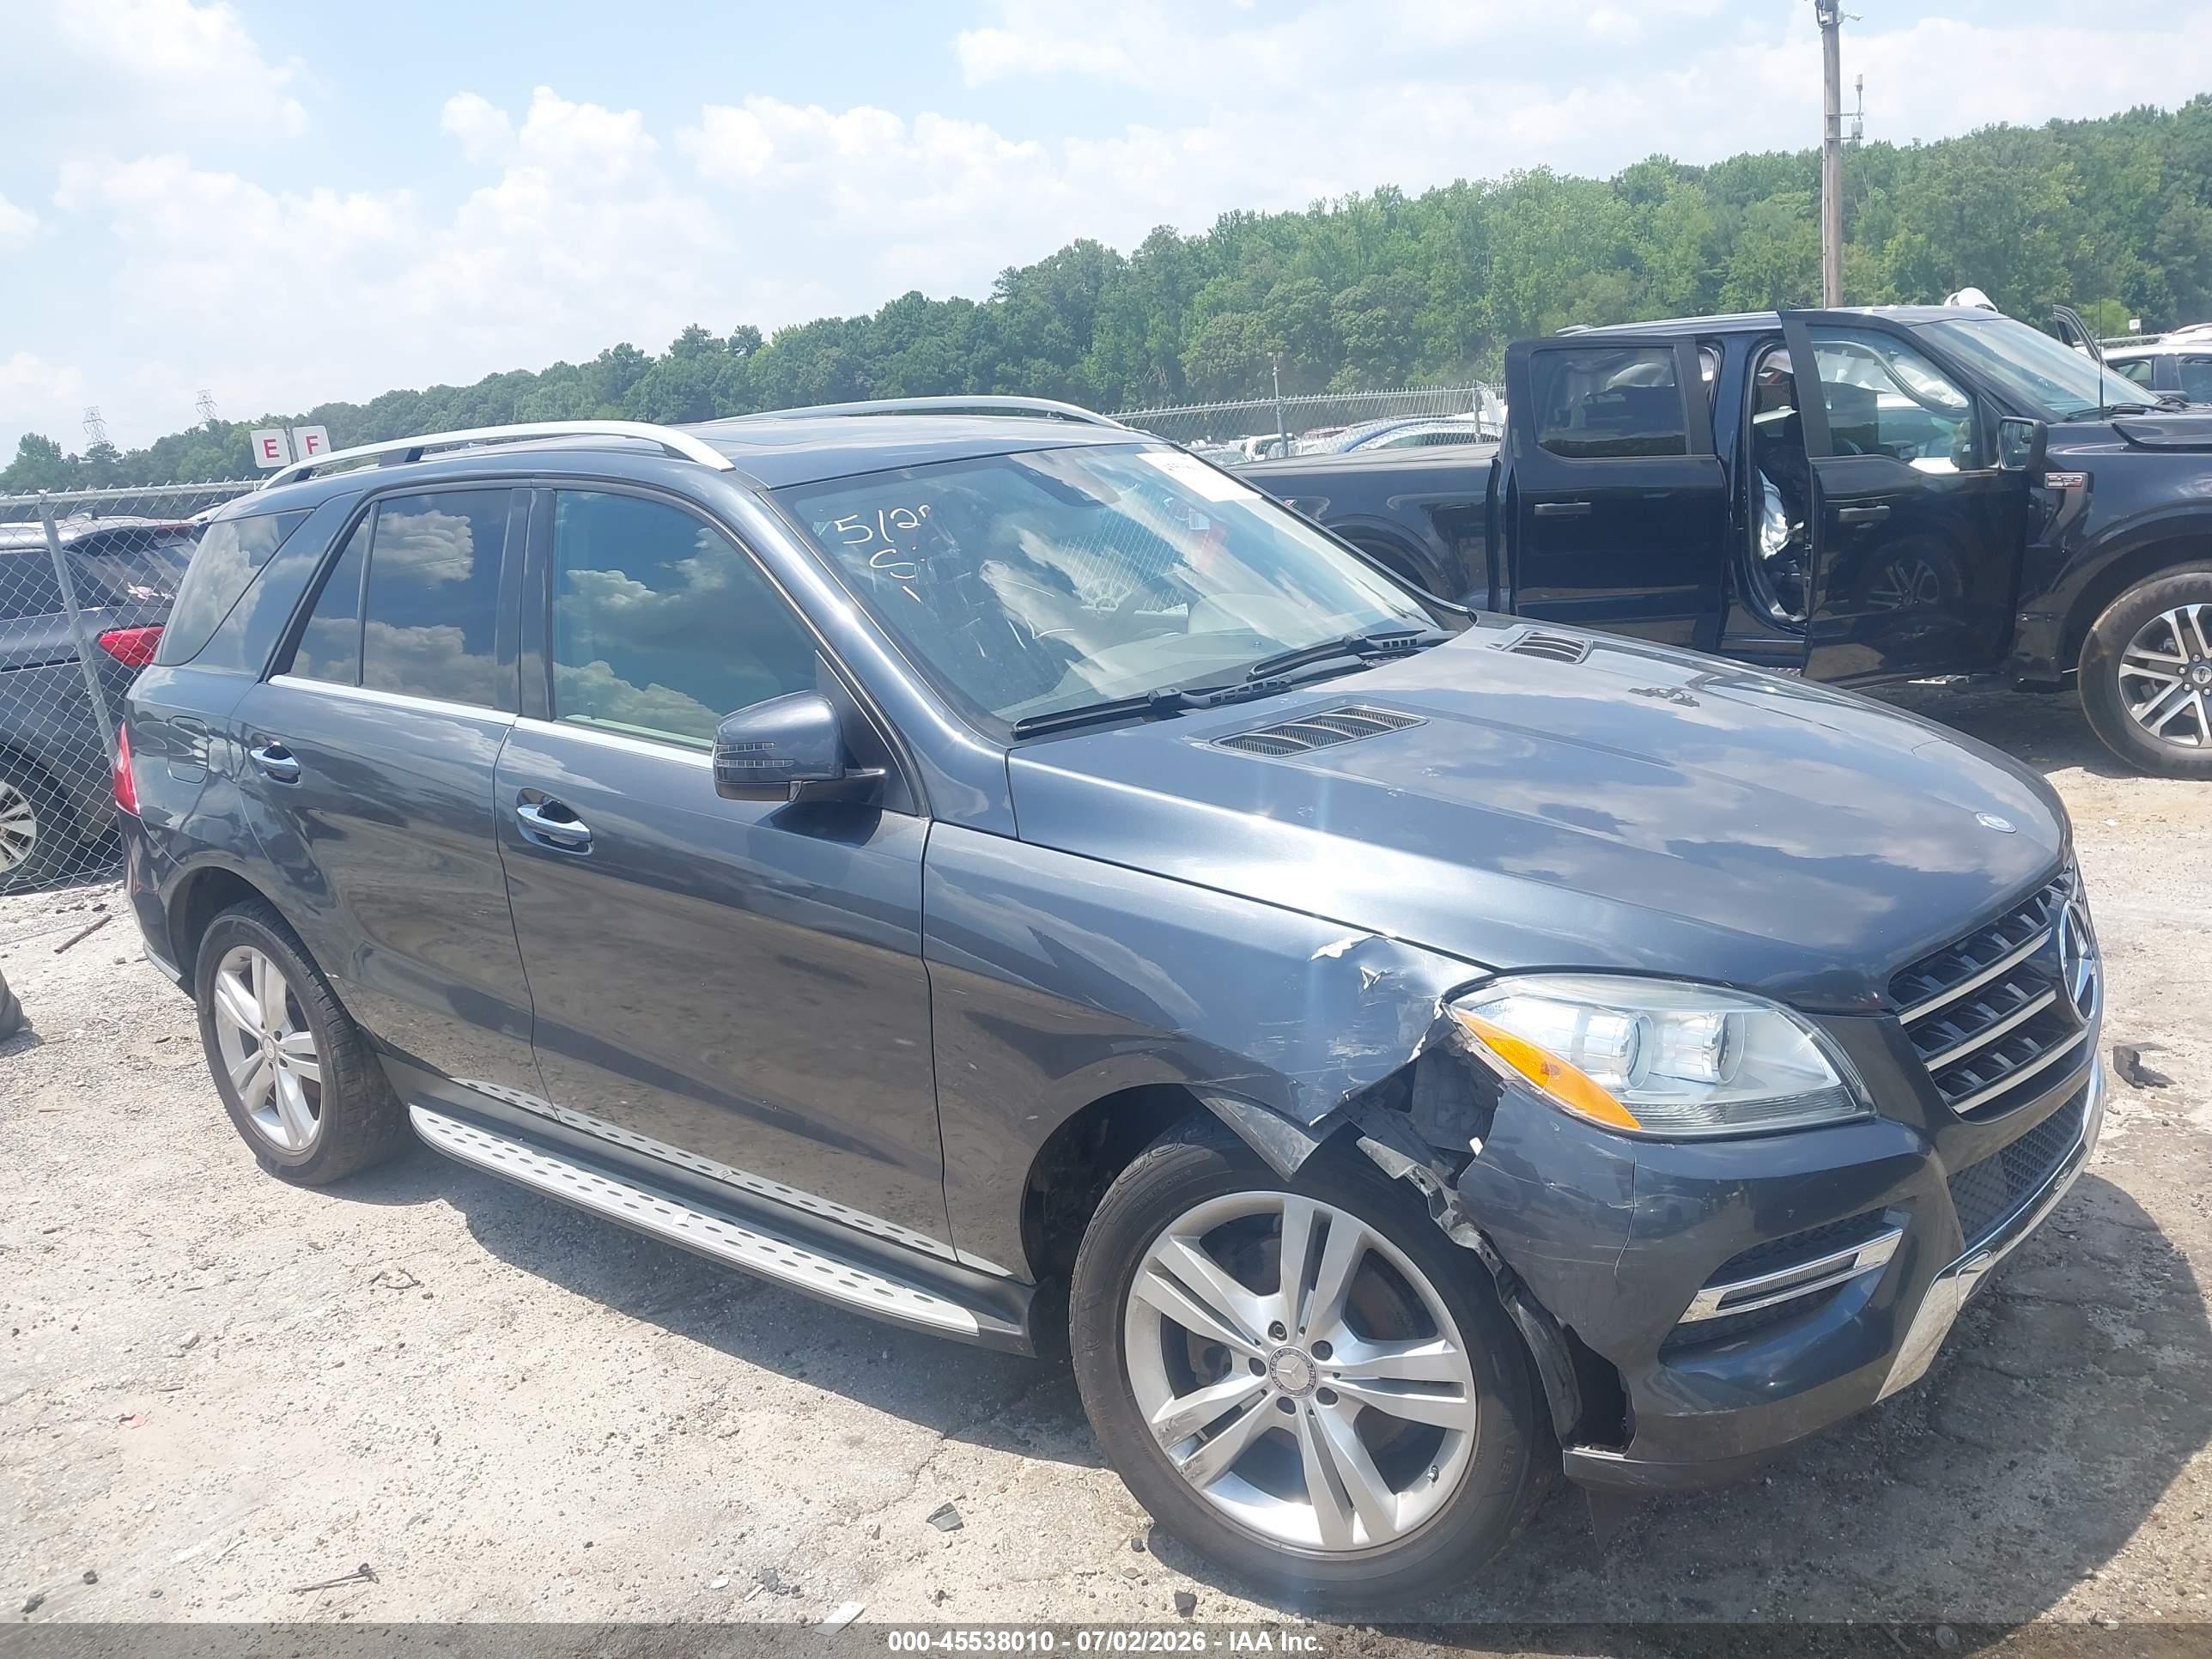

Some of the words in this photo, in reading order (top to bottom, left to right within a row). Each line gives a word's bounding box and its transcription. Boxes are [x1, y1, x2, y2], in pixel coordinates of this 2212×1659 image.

[263, 439, 280, 459] E
[306, 435, 319, 454] F
[1270, 1352, 1282, 1387] MERCEDES
